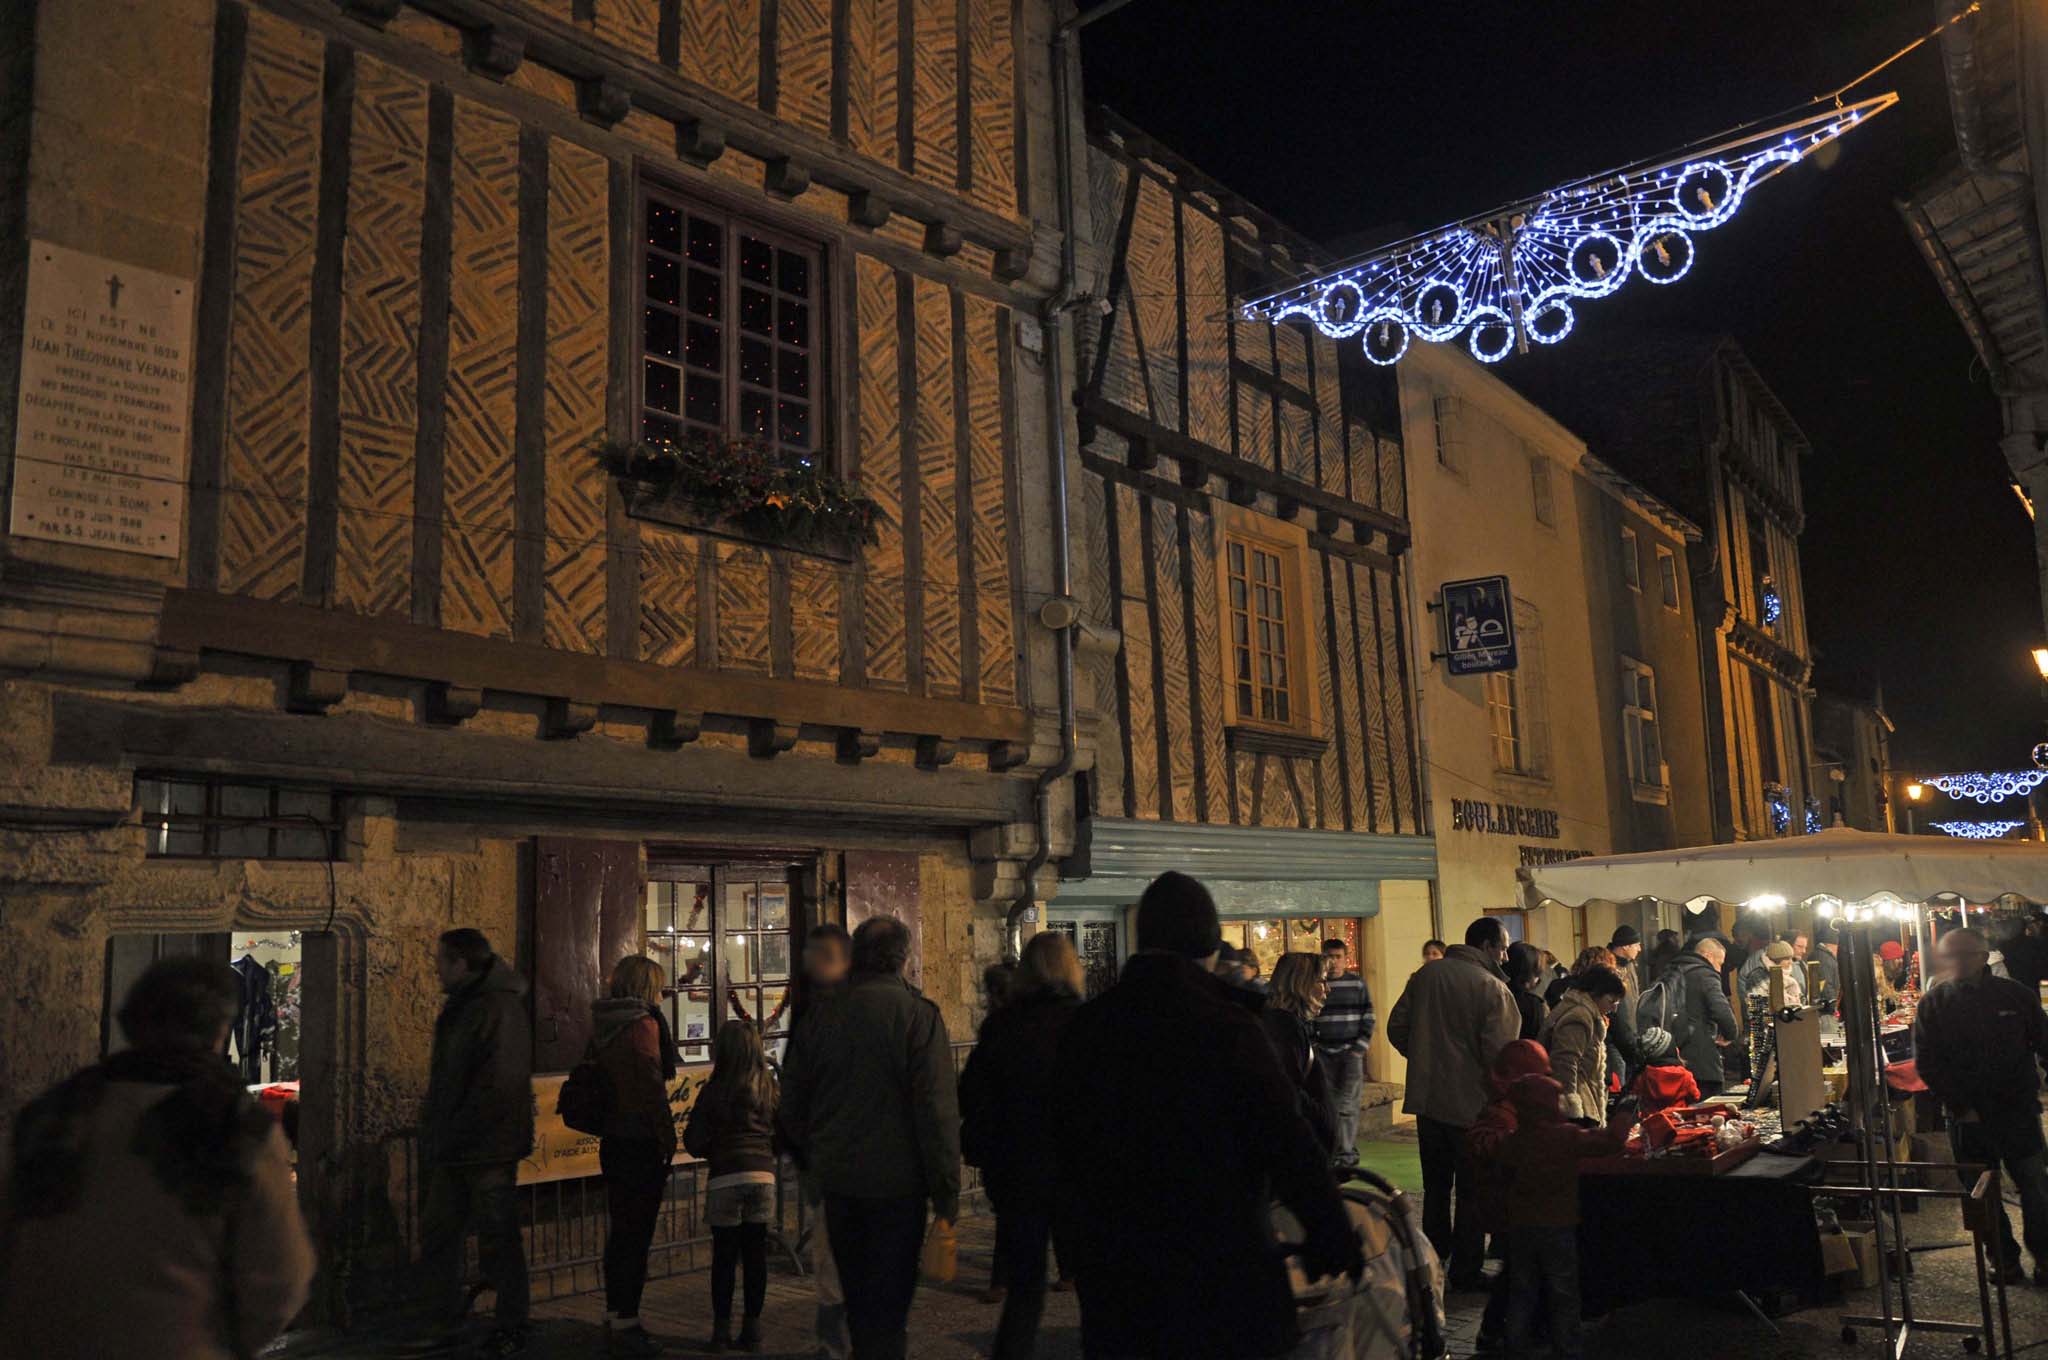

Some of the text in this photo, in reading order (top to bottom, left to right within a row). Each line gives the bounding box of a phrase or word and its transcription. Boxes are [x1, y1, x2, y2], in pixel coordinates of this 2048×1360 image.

[31, 335, 60, 354] JEAN
[86, 329, 147, 353] NOVEMBRE
[1451, 798, 1560, 839] BOULANGERIE
